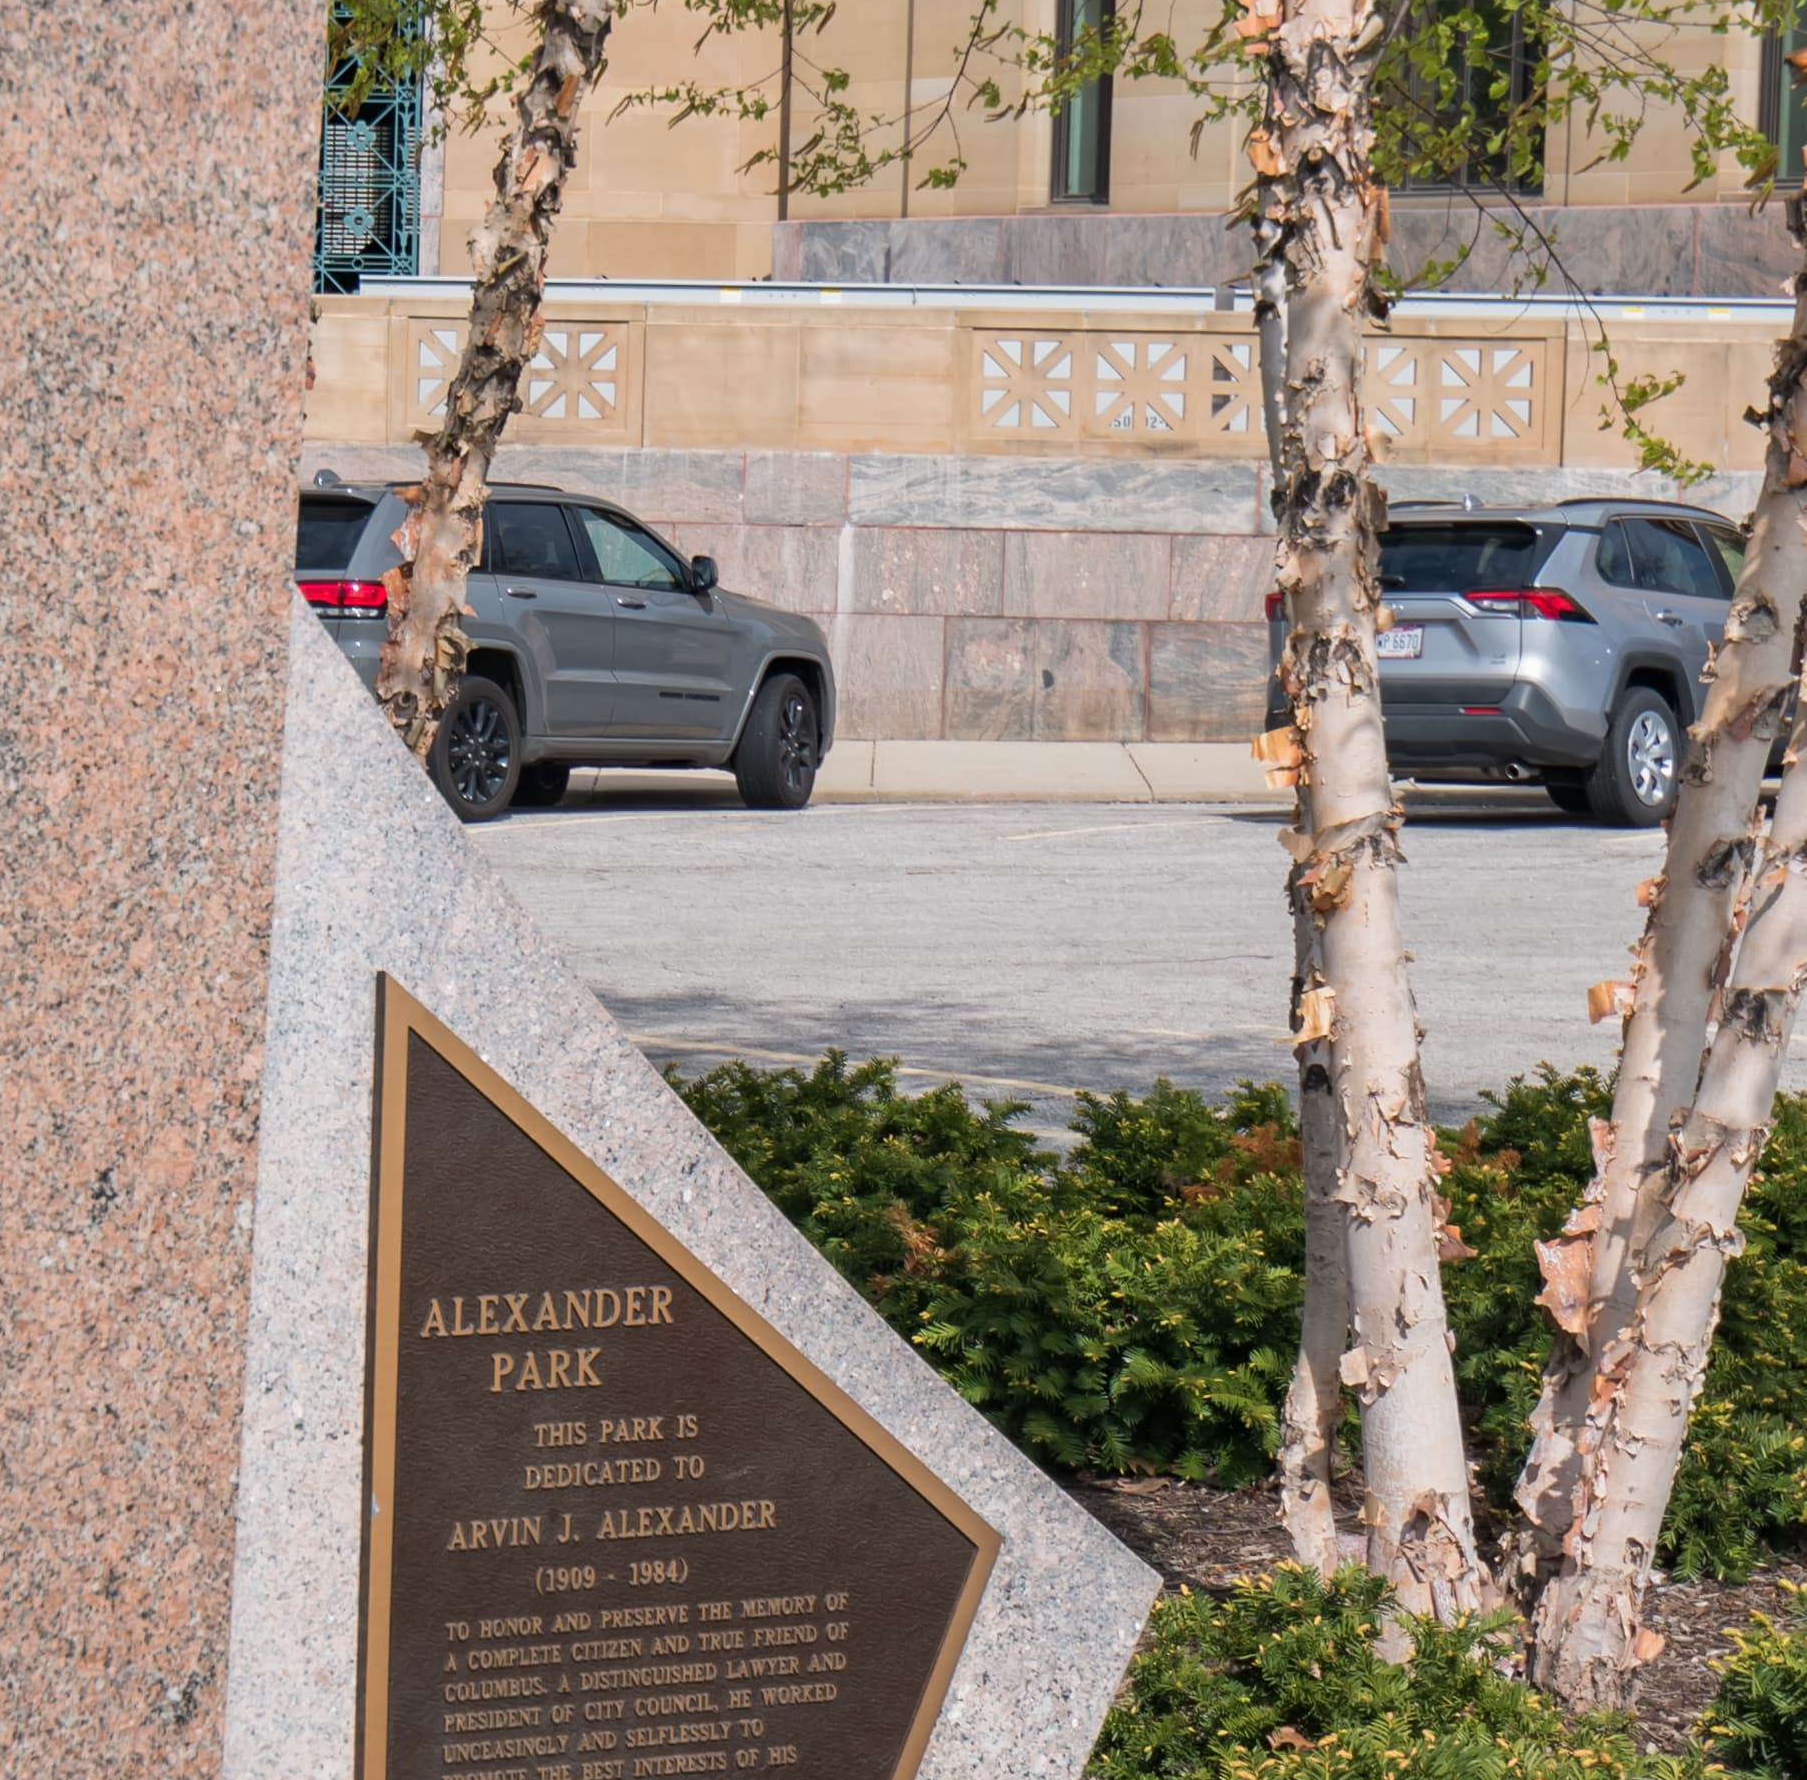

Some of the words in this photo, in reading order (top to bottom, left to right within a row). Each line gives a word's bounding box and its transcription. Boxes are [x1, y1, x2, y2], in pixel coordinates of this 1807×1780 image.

[1393, 634, 1419, 650] 6670
[420, 1285, 674, 1338] ALEXANDER
[490, 1347, 602, 1392] PARK
[533, 1421, 587, 1447] THIS
[598, 1416, 664, 1443] PARK
[676, 1414, 698, 1438] IS
[524, 1458, 661, 1490] DEDICATED
[672, 1455, 705, 1479] TO
[447, 1515, 542, 1551] ARVIN
[557, 1513, 580, 1543] J.
[596, 1499, 776, 1540] ALEXANDER
[535, 1565, 596, 1594] (1909
[628, 1557, 689, 1586] 1984)
[445, 1621, 470, 1641] TO
[479, 1616, 543, 1638] HONOR
[551, 1612, 592, 1633] AND
[600, 1604, 689, 1629] PRESERVE
[697, 1601, 732, 1621] THE
[740, 1594, 817, 1618] MEMORY
[824, 1592, 849, 1612] OF
[444, 1653, 457, 1672] A
[468, 1644, 562, 1670] COMPLETE
[570, 1638, 642, 1661] CITIZEN
[650, 1634, 690, 1655] AND
[697, 1630, 745, 1651] TRUE
[752, 1624, 818, 1647] FRIEND
[825, 1621, 850, 1641] OF
[445, 1676, 548, 1702] COLUMBUS.
[557, 1674, 570, 1693] A
[579, 1662, 718, 1691] DISTINGUISHED
[725, 1655, 799, 1679] LAWYER
[807, 1652, 847, 1672] AND
[443, 1706, 542, 1733] PRESIDENT
[551, 1703, 575, 1724] OF
[584, 1699, 626, 1720] CITY
[634, 1692, 719, 1717] COUNCIL,
[726, 1688, 752, 1709] HE
[760, 1682, 838, 1706] WORKED
[442, 1734, 569, 1764] UNCEASINGLY
[576, 1730, 617, 1751] AND
[625, 1721, 732, 1748] SELFLESSLY
[738, 1718, 764, 1738] TO
[581, 1759, 625, 1780] BEST
[633, 1751, 727, 1777] INTERESTS
[735, 1748, 760, 1768] OF
[768, 1744, 798, 1765] HIS
